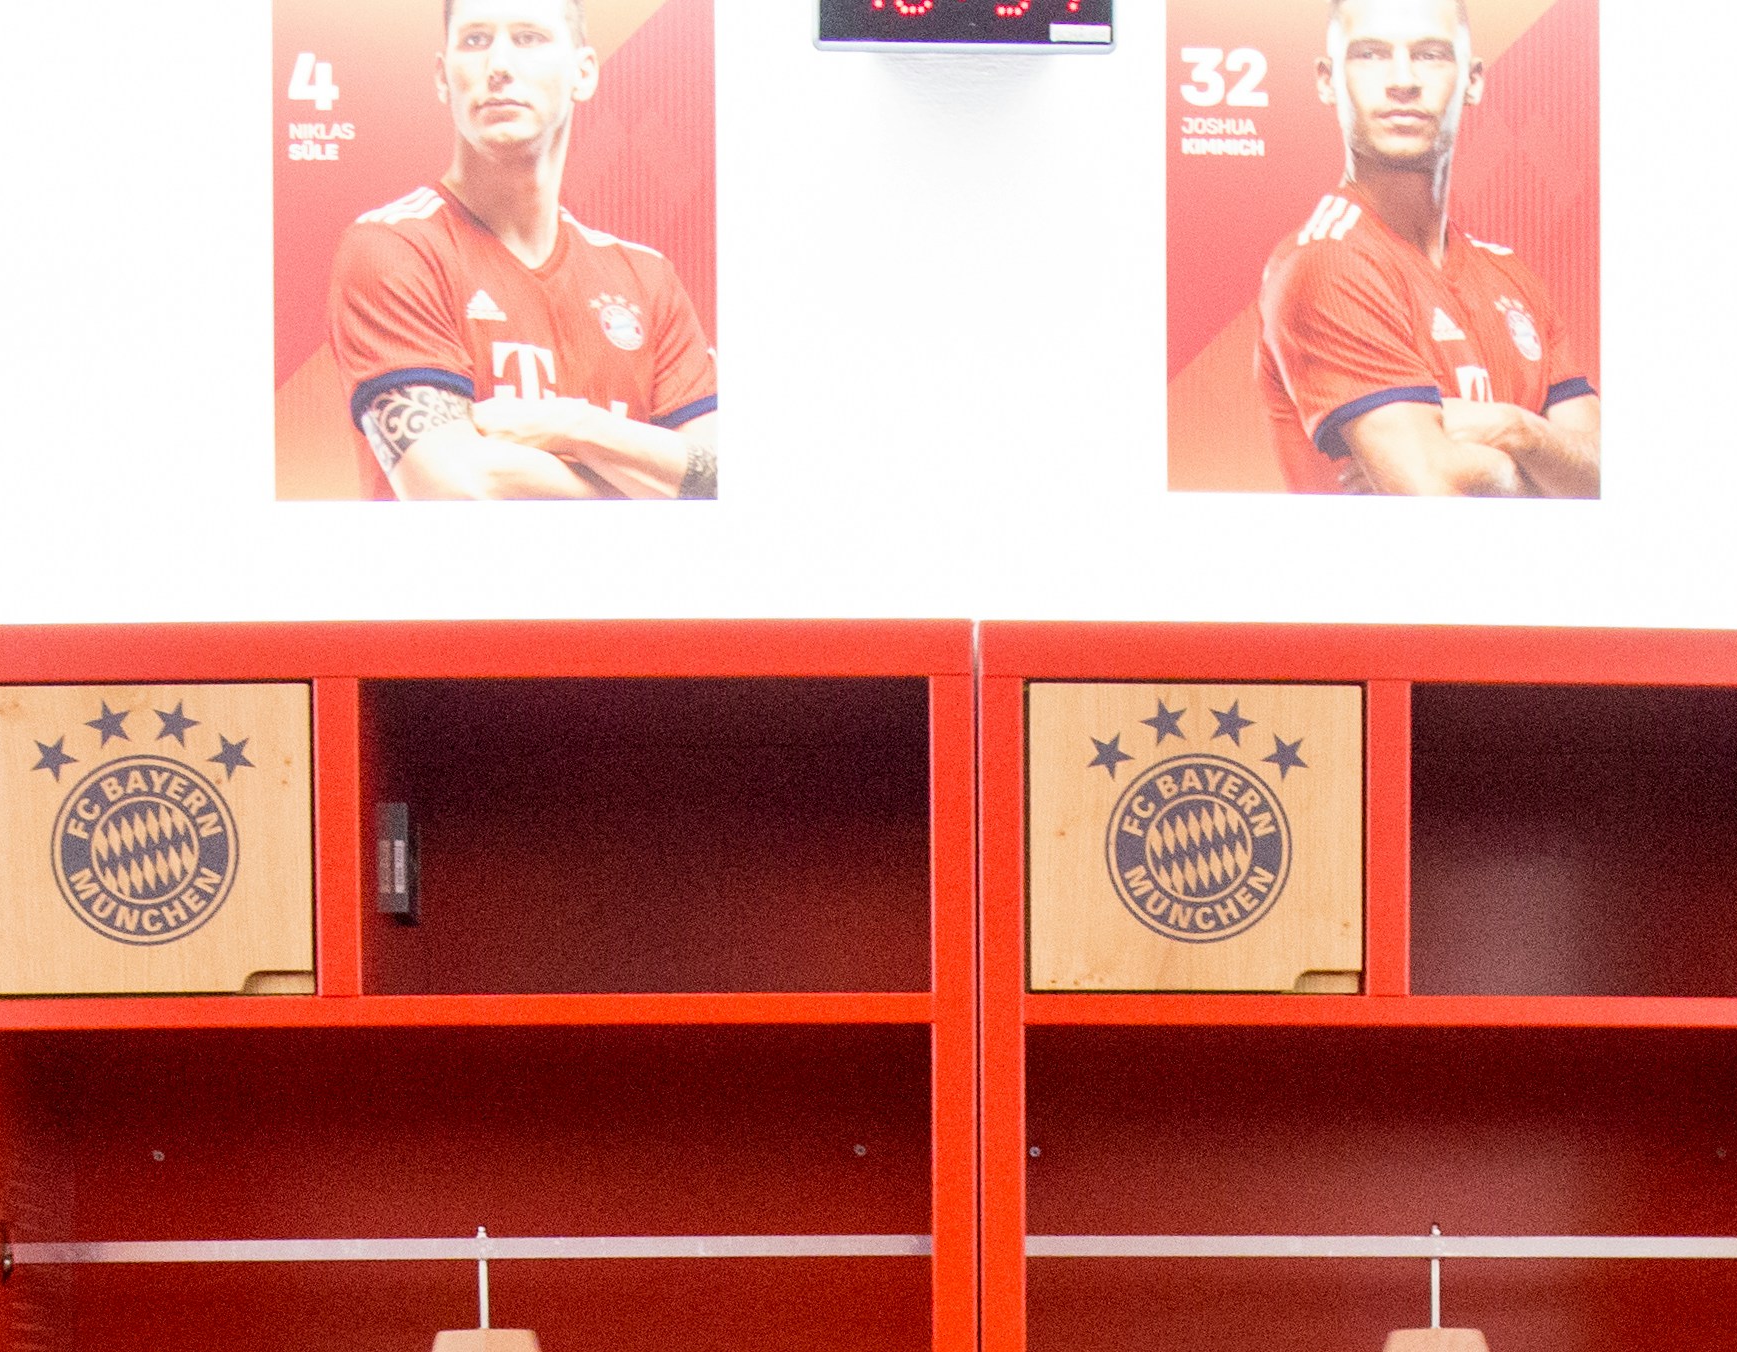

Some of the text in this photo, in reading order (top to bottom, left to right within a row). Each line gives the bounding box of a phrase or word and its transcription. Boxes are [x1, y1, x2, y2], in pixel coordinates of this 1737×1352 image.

[289, 52, 338, 110] 4
[1181, 47, 1268, 106] 32
[289, 123, 354, 141] NIKLAS
[1182, 117, 1255, 134] JOSHUA
[289, 140, 338, 160] SÜLE
[1182, 138, 1264, 155] KIMMICH
[66, 770, 222, 840] FC BAYERN
[1122, 768, 1276, 838] FC BAYERN
